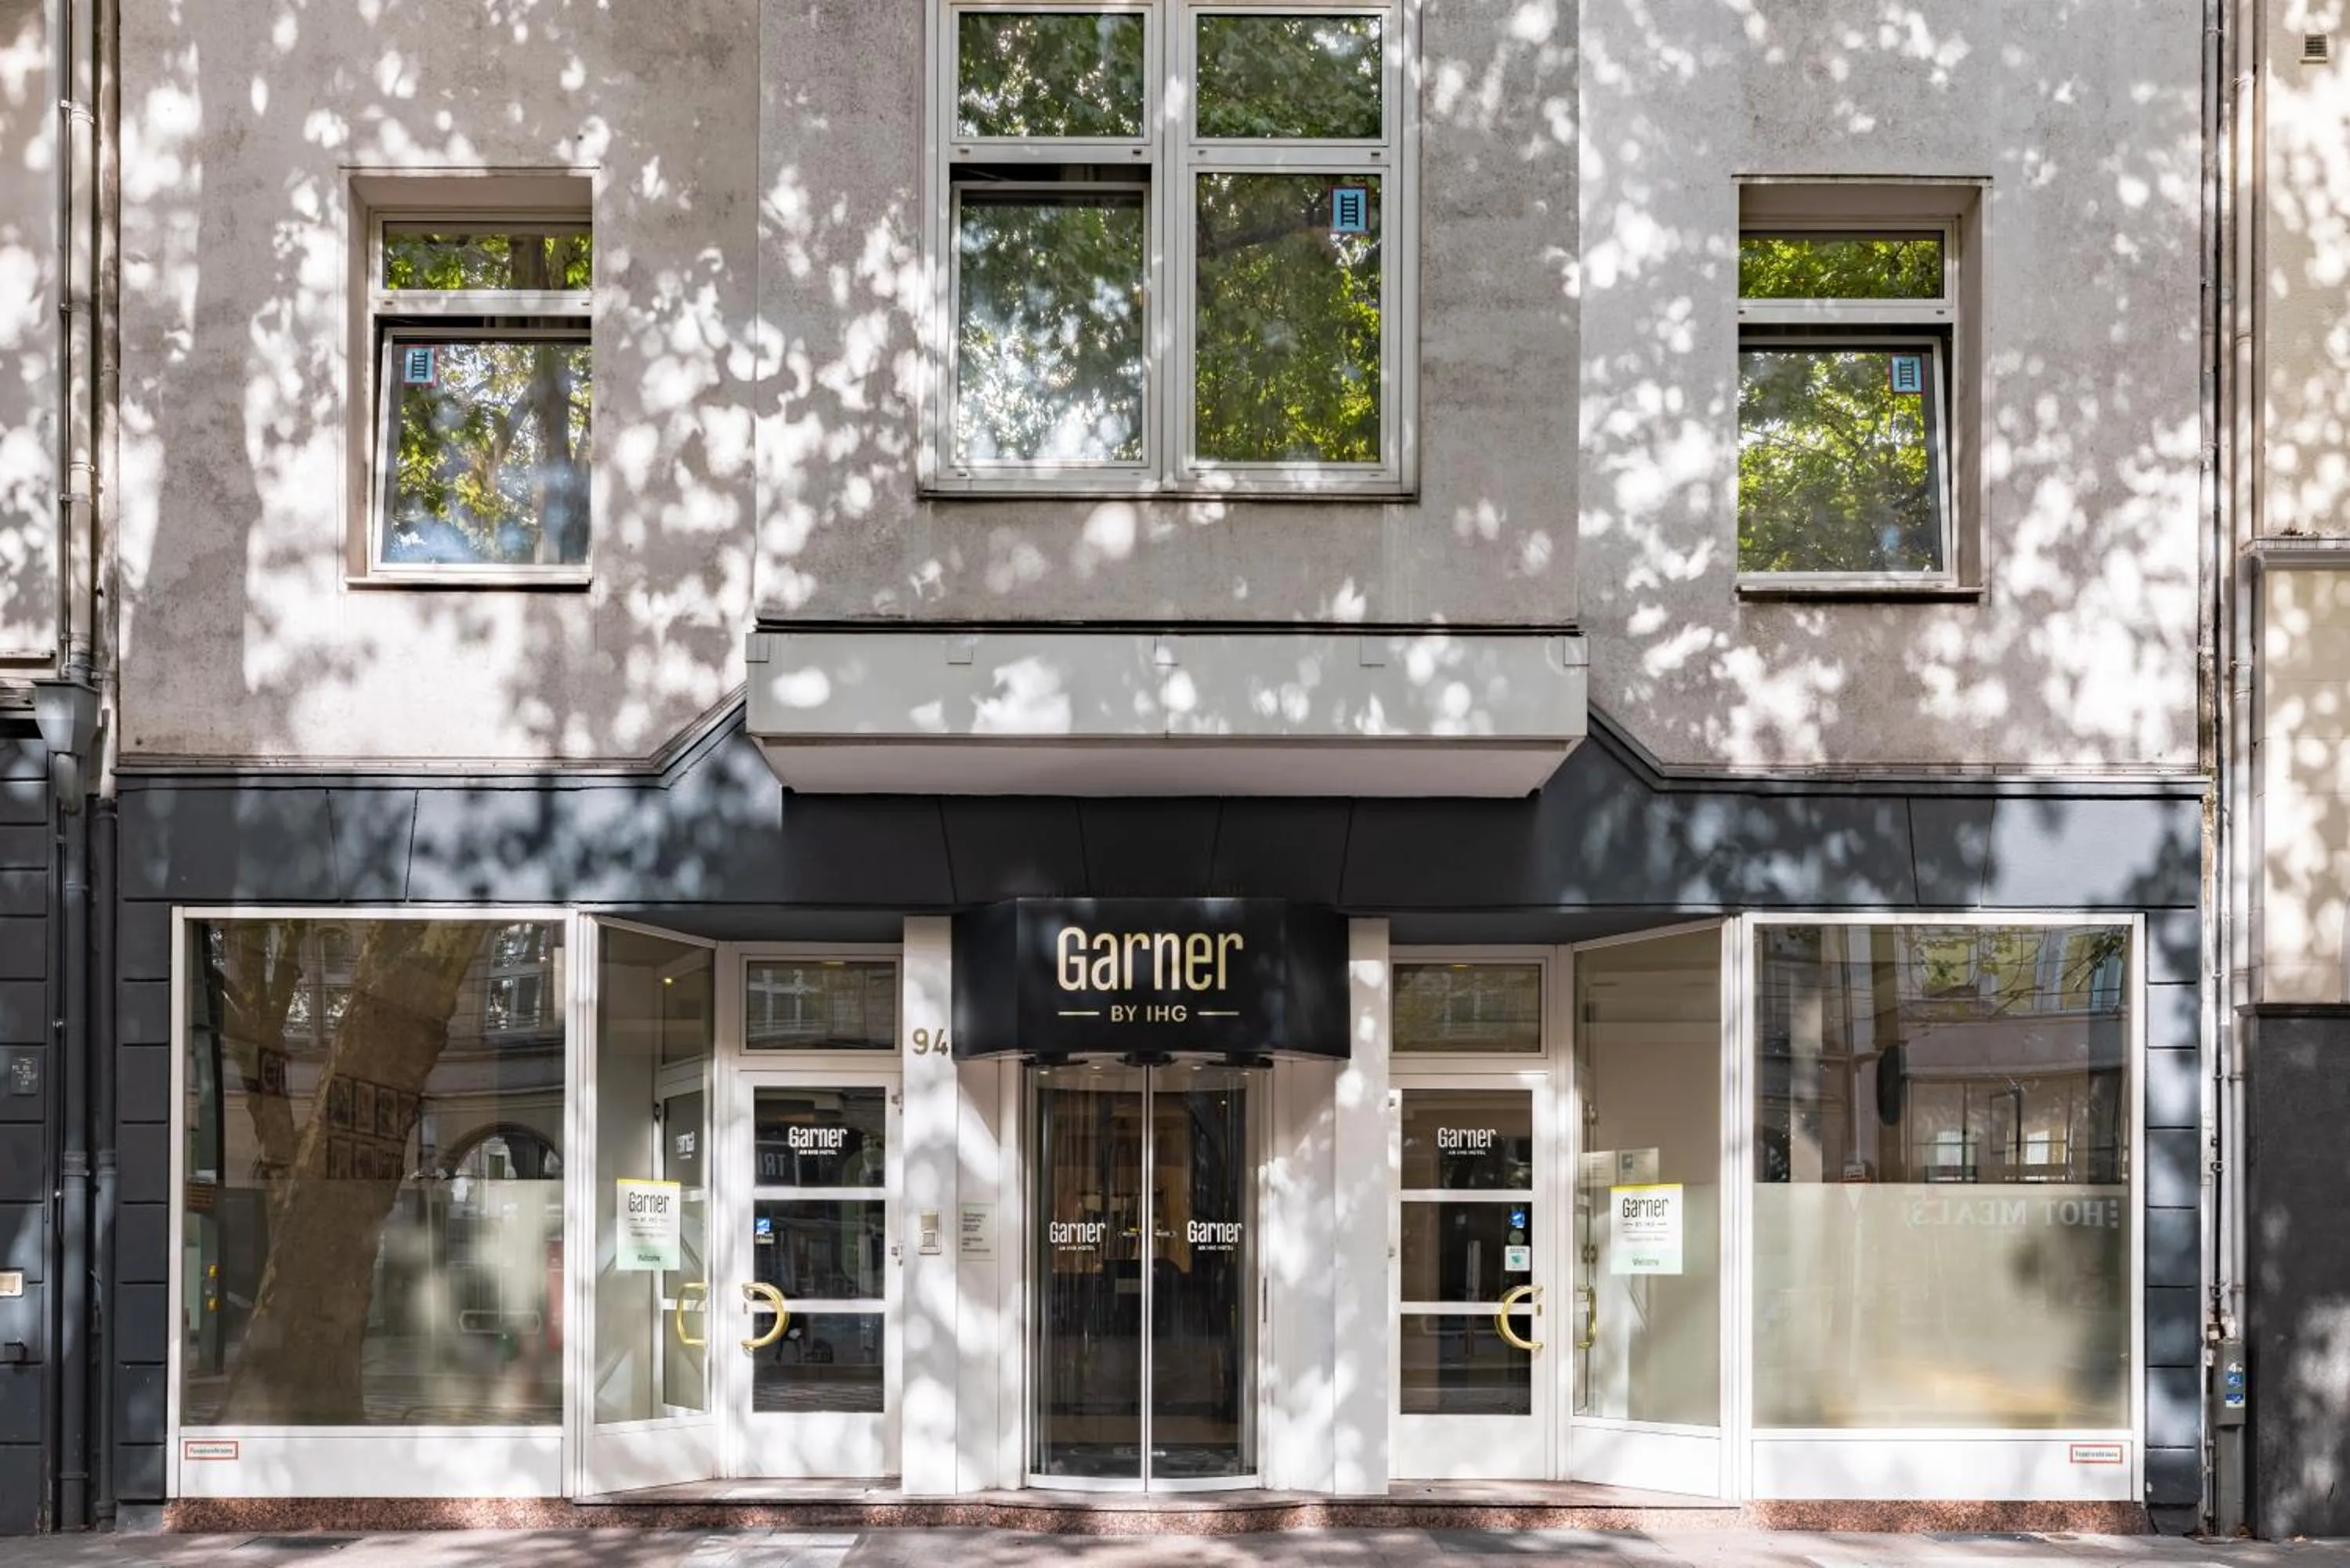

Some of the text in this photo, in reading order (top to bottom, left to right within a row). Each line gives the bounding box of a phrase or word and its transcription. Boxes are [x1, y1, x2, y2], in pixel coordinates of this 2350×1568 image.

[1058, 927, 1244, 991] Garner
[1111, 1005, 1188, 1022] BY IHG
[913, 1028, 949, 1056] 94
[789, 1126, 848, 1148] Garner
[1437, 1127, 1496, 1148] Garner
[629, 1191, 670, 1214] Garner
[1622, 1198, 1669, 1218] Garner
[1050, 1221, 1105, 1243] Garner
[1187, 1219, 1243, 1243] Garner
